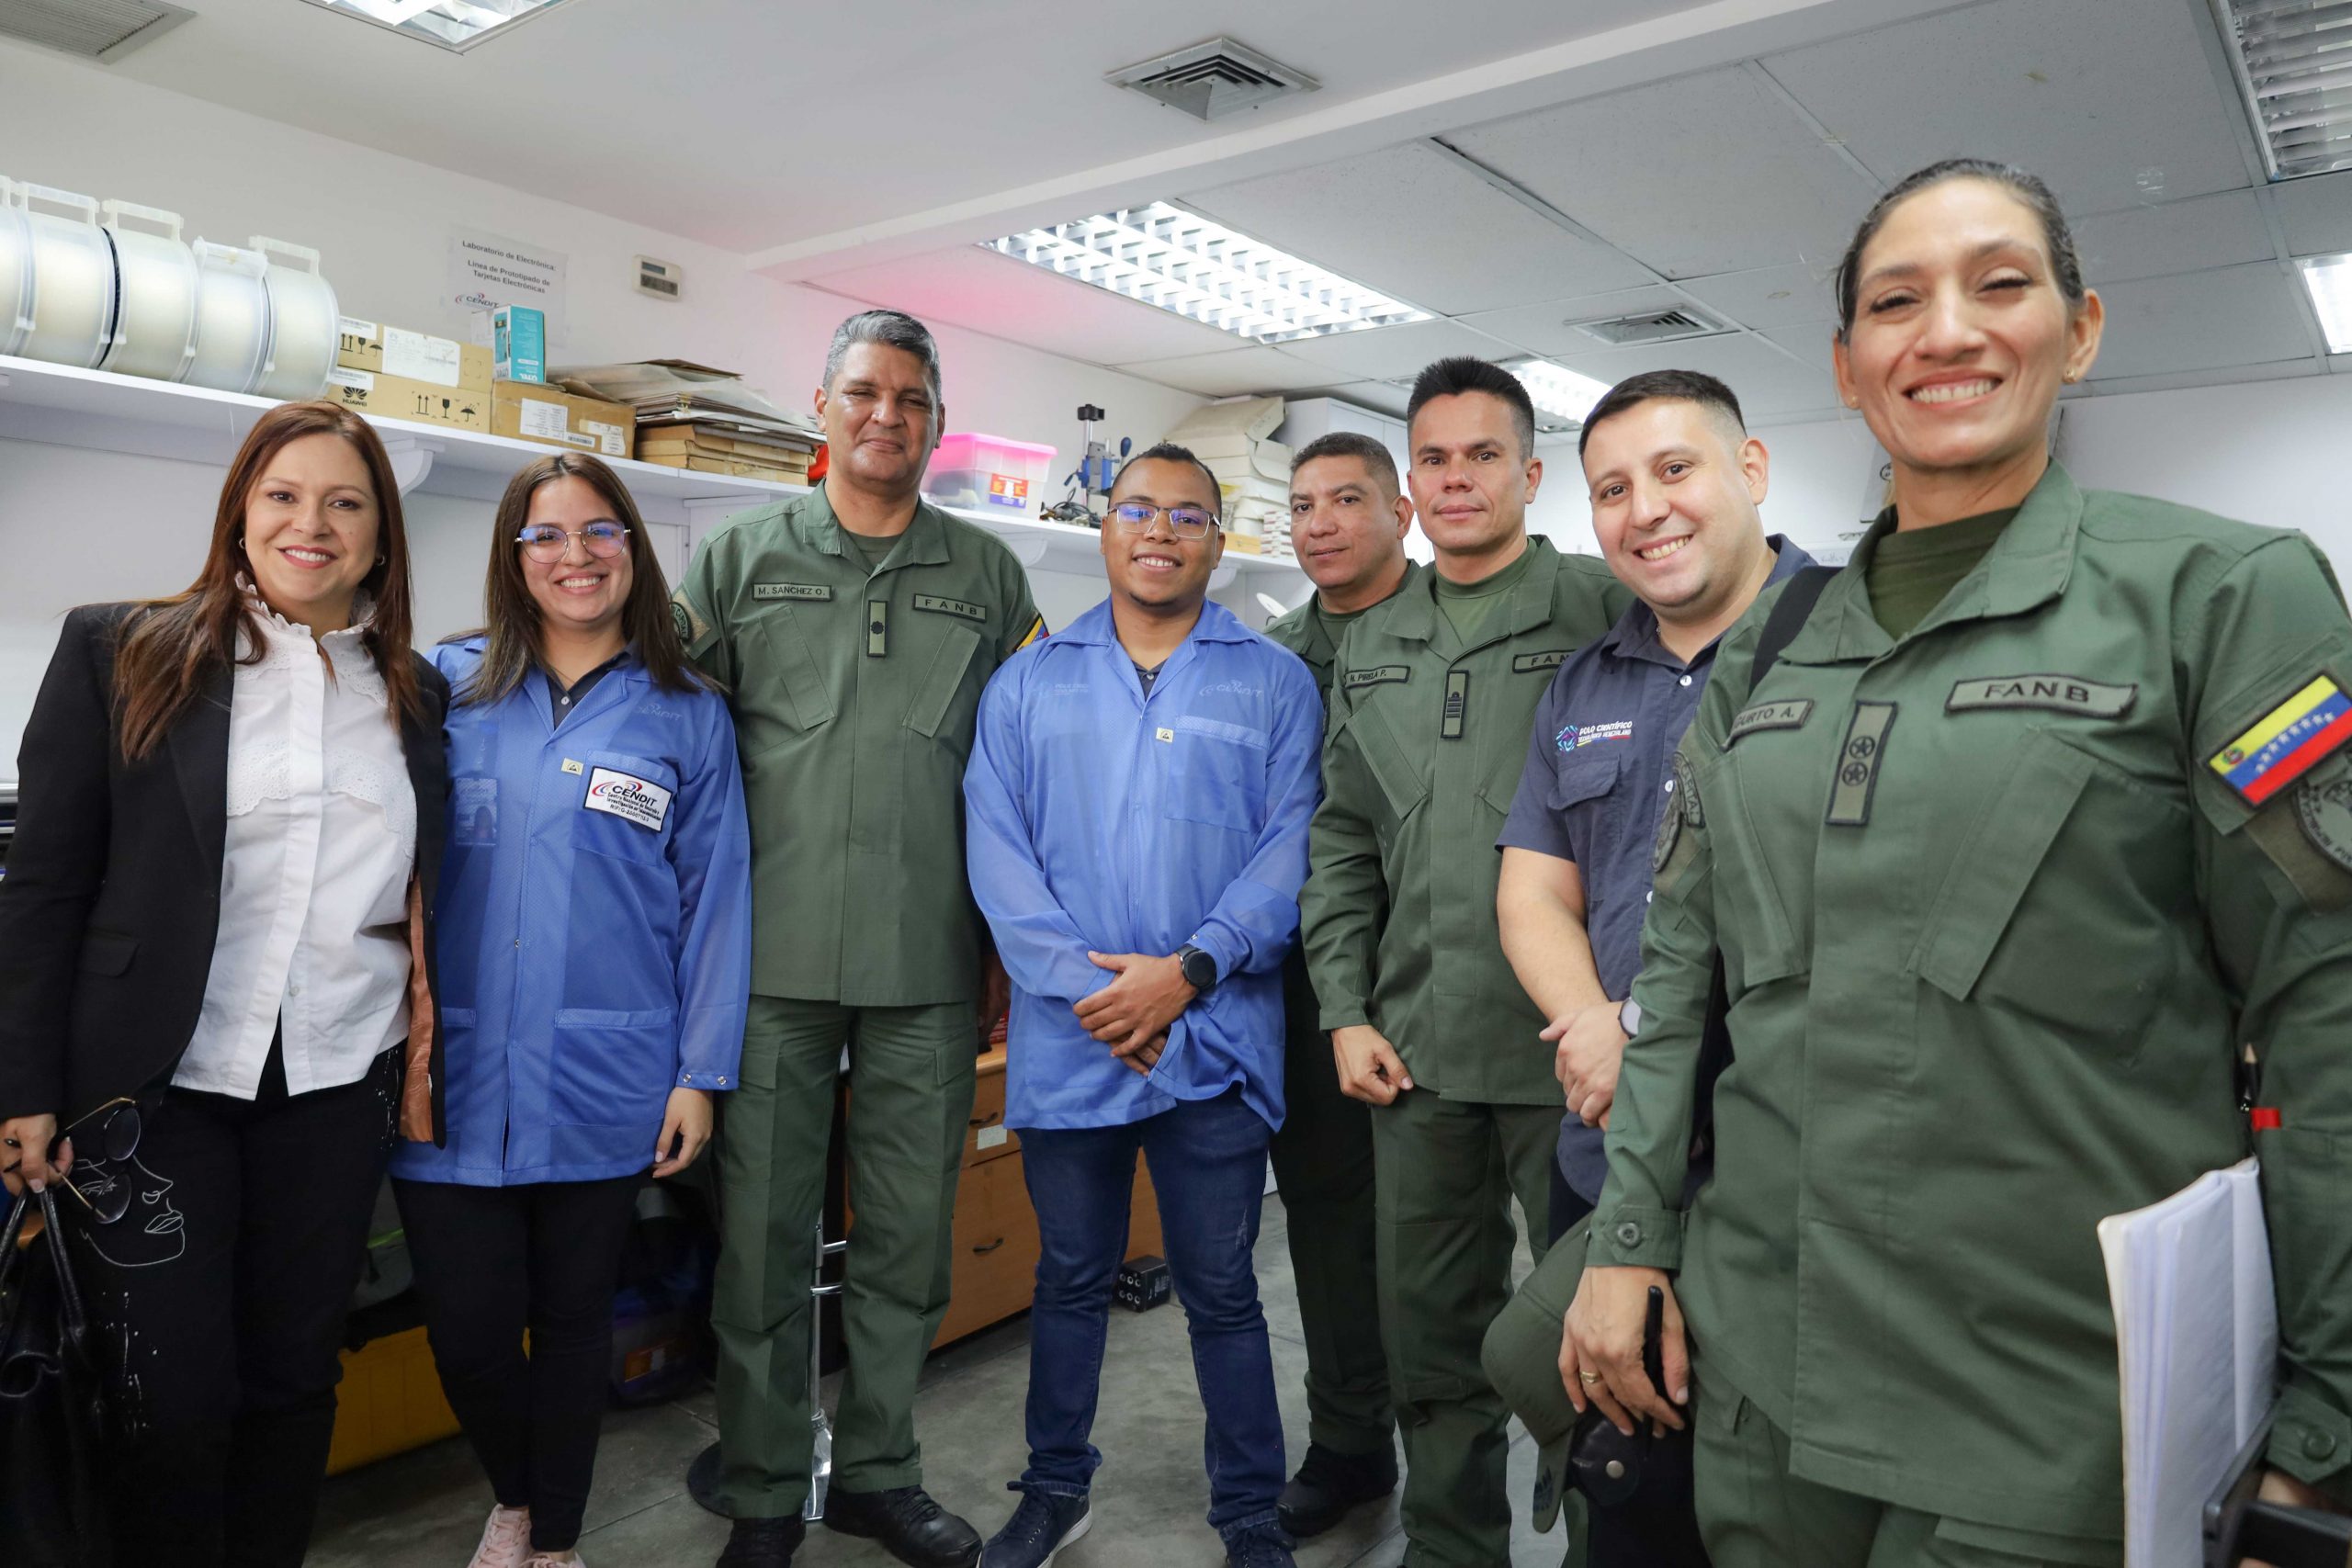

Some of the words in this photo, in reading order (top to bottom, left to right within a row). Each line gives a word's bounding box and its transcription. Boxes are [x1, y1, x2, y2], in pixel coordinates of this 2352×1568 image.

[462, 240, 504, 256] Laboratorio
[505, 252, 514, 260] de
[473, 270, 501, 283] Tarjetas
[489, 265, 498, 273] de
[500, 267, 540, 284] Prototipado
[542, 278, 550, 287] de
[466, 295, 500, 309] CENDIT
[343, 399, 368, 407] HUAWEI
[758, 587, 770, 595] M.
[772, 586, 813, 595] SANCHEZ
[815, 588, 825, 596] O.
[1357, 671, 1378, 682] PIRELA
[1380, 669, 1386, 677] P.
[1984, 681, 2089, 704] FANB
[1781, 706, 1794, 718] A.
[1579, 725, 1596, 736] POLO
[612, 785, 657, 807] CENDIT
